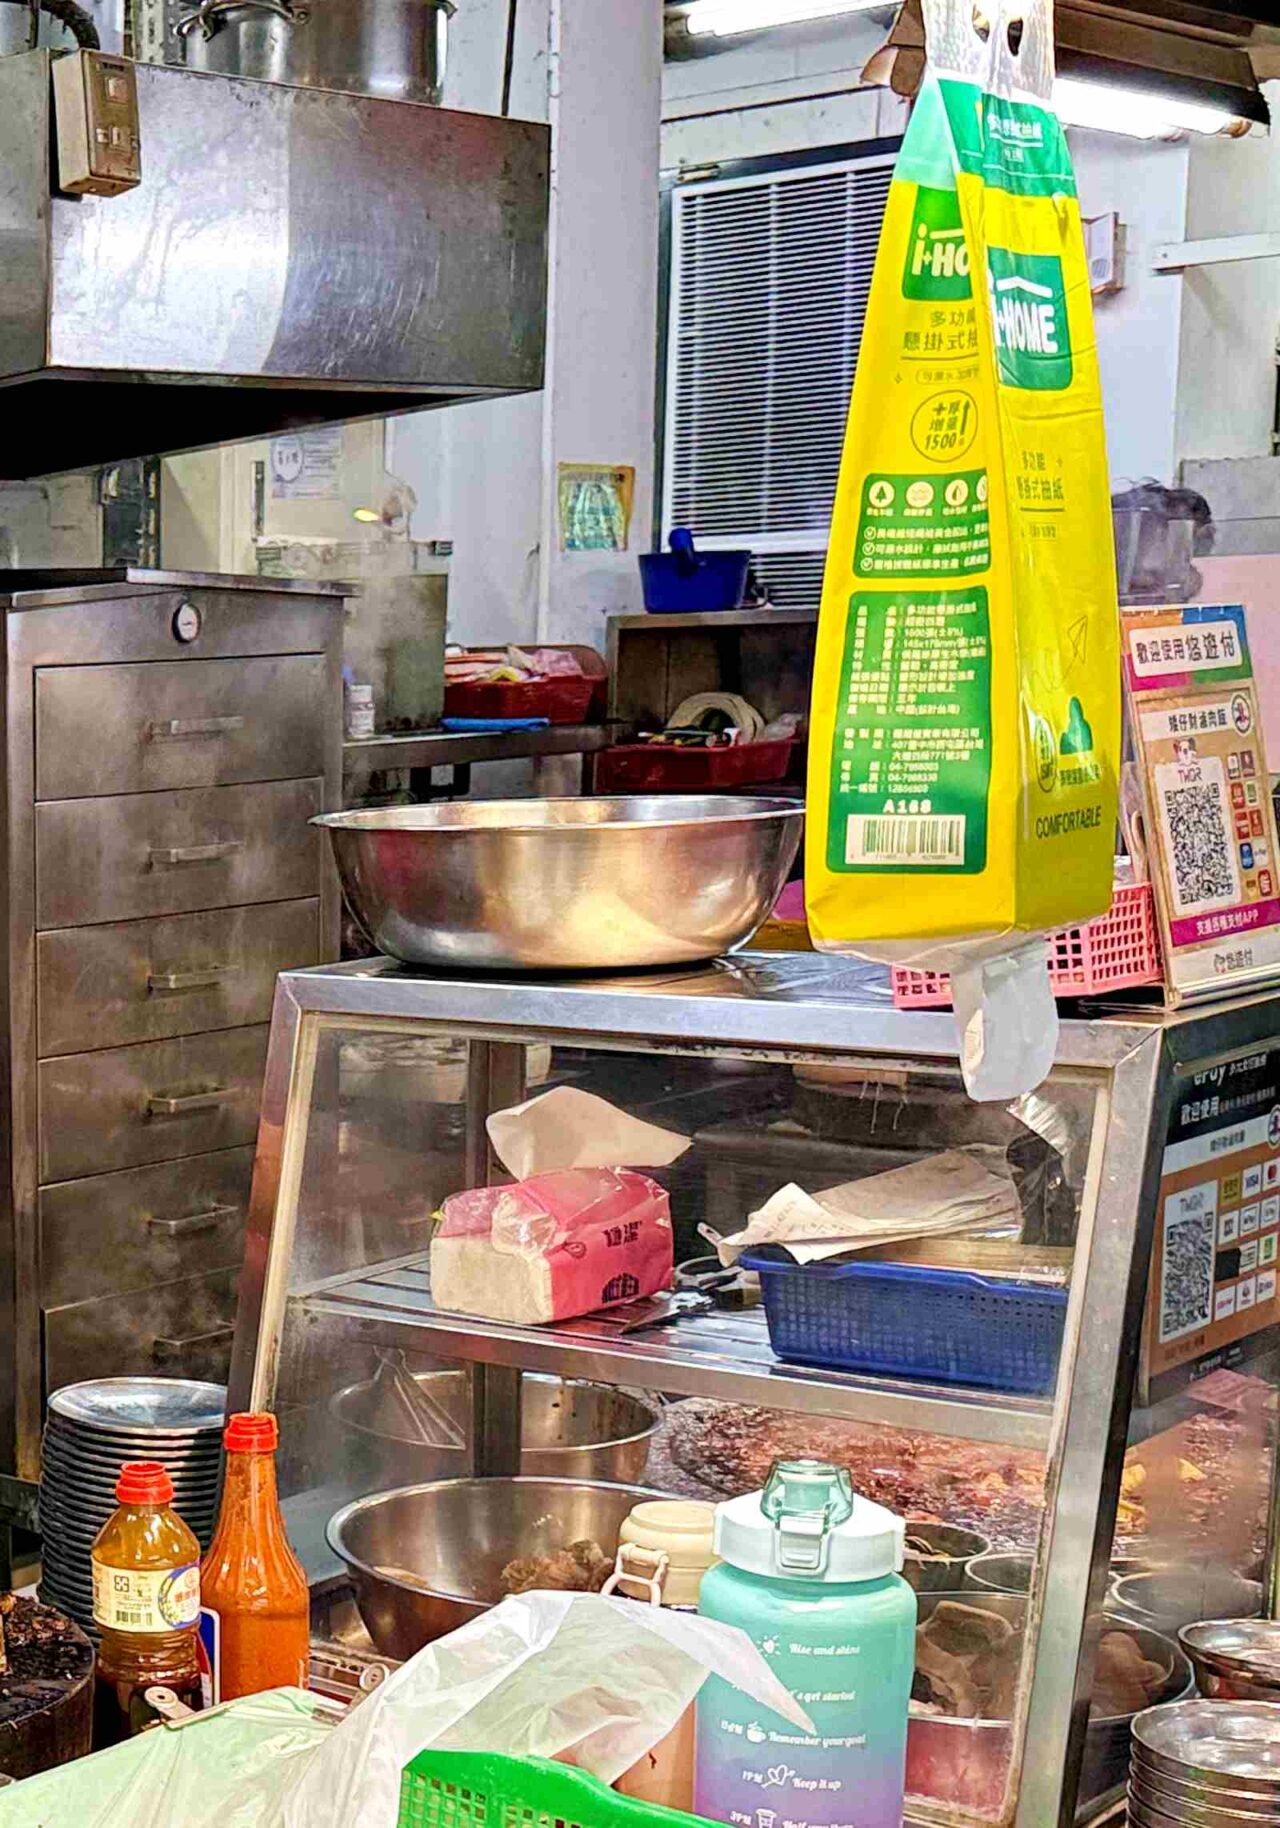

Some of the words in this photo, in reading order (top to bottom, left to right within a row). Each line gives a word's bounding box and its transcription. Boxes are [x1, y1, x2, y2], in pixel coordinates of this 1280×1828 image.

[1035, 806, 1102, 839] COMFORTABLE
[767, 1730, 822, 1747] Remember
[791, 1776, 818, 1792] Keep
[828, 1780, 842, 1792] up
